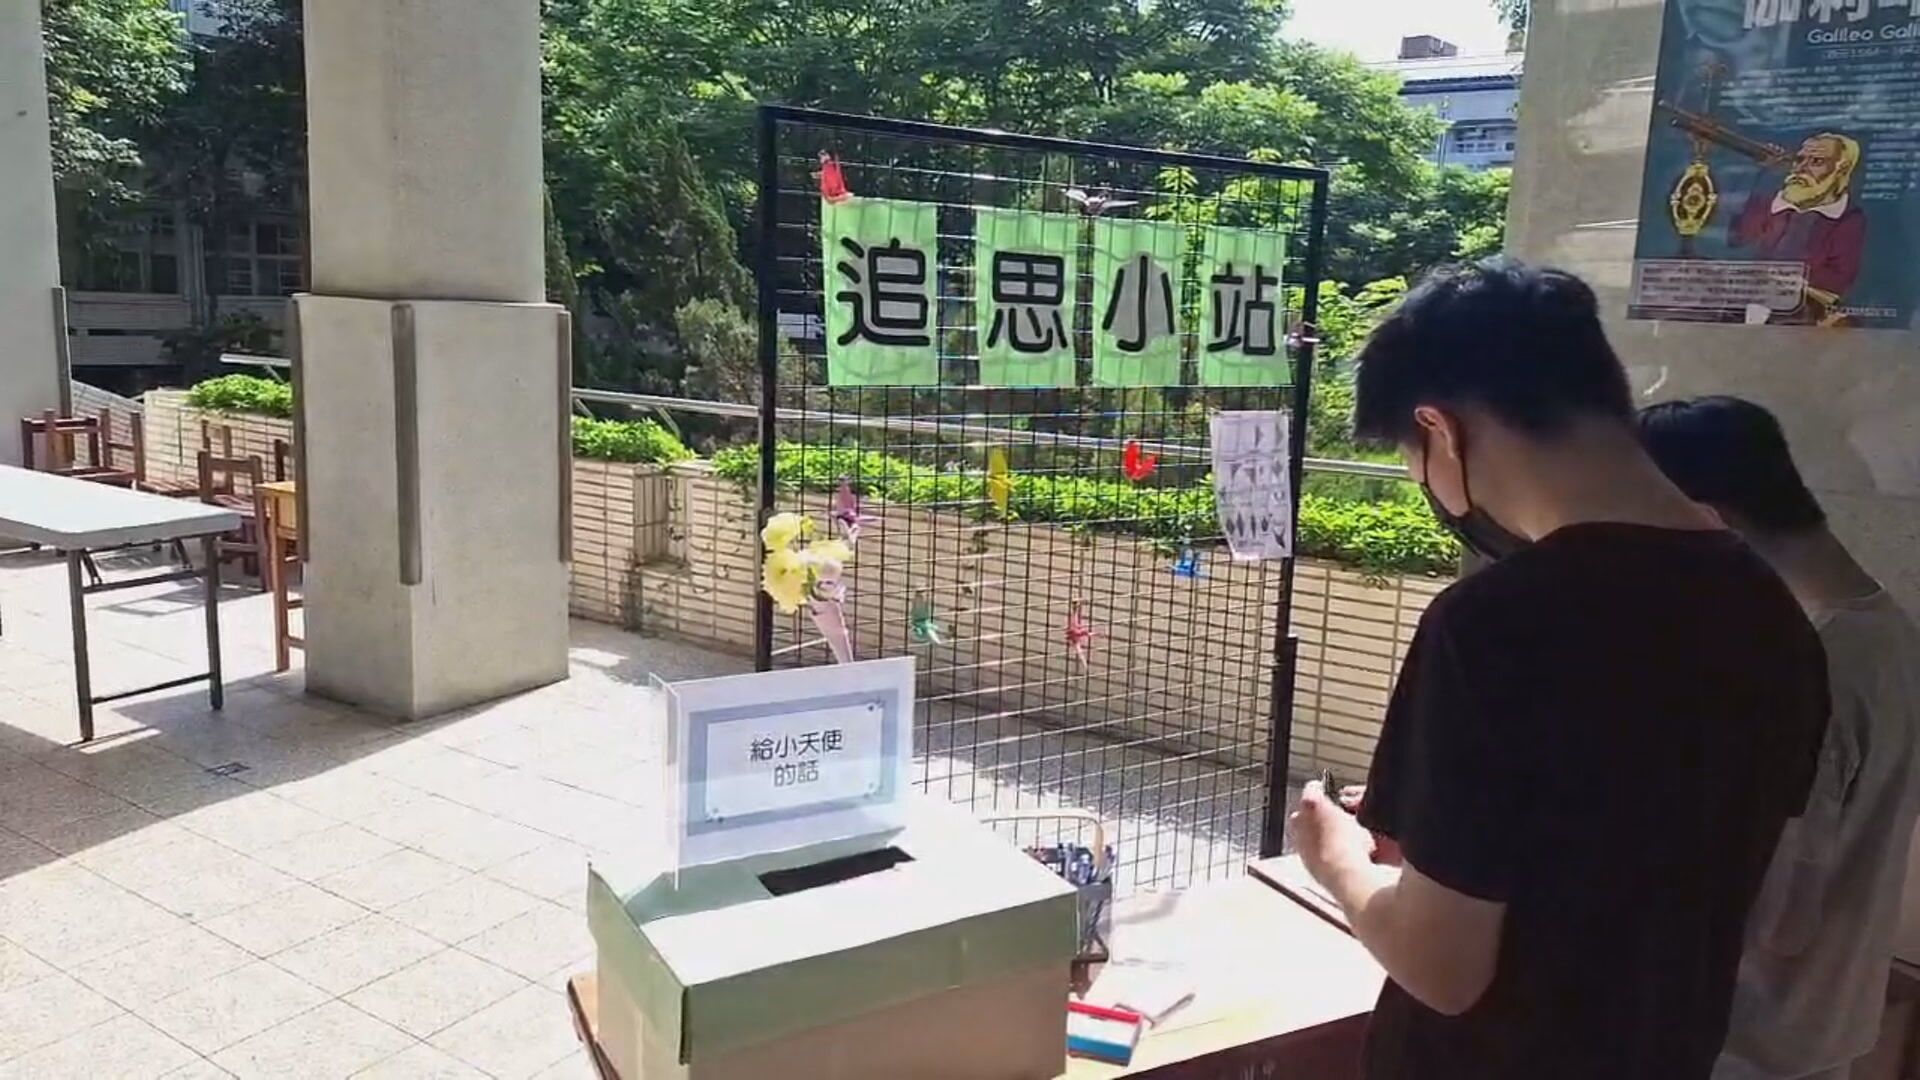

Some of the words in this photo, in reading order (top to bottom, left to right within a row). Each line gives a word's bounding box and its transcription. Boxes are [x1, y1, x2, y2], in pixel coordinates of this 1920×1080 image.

[1807, 27, 1874, 44] Galileo
[837, 237, 1278, 356] 追思小站
[750, 729, 843, 762] 給小天使
[774, 759, 819, 788] 的話
